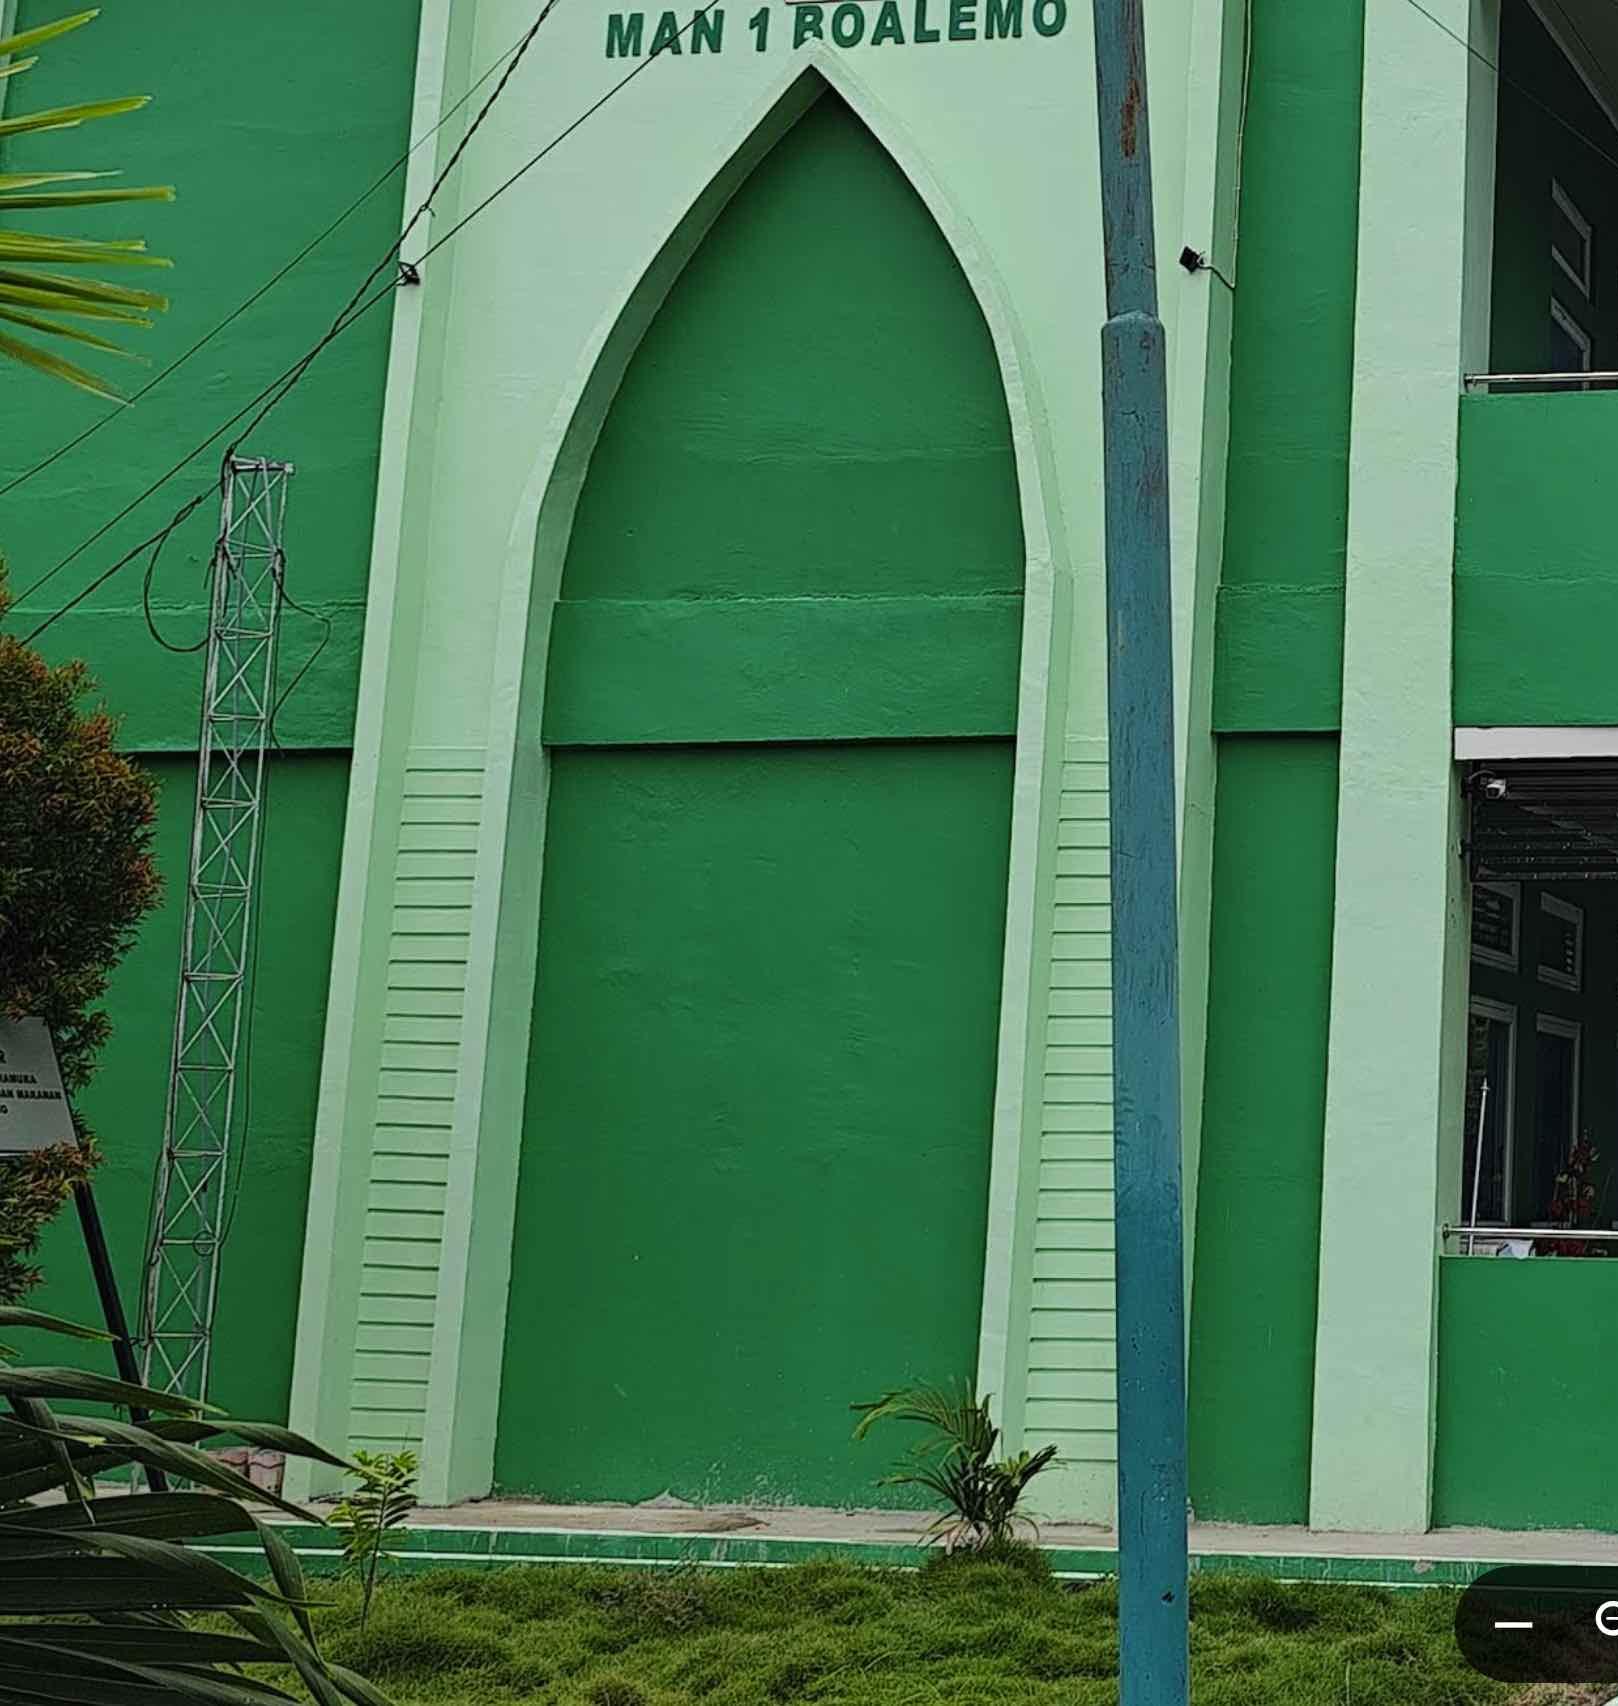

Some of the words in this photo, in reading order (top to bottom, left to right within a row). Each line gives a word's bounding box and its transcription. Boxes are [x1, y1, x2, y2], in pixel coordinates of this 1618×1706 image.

[605, 9, 724, 58] MAN
[748, 7, 769, 52] 1
[793, 0, 1067, 49] BOALEMO
